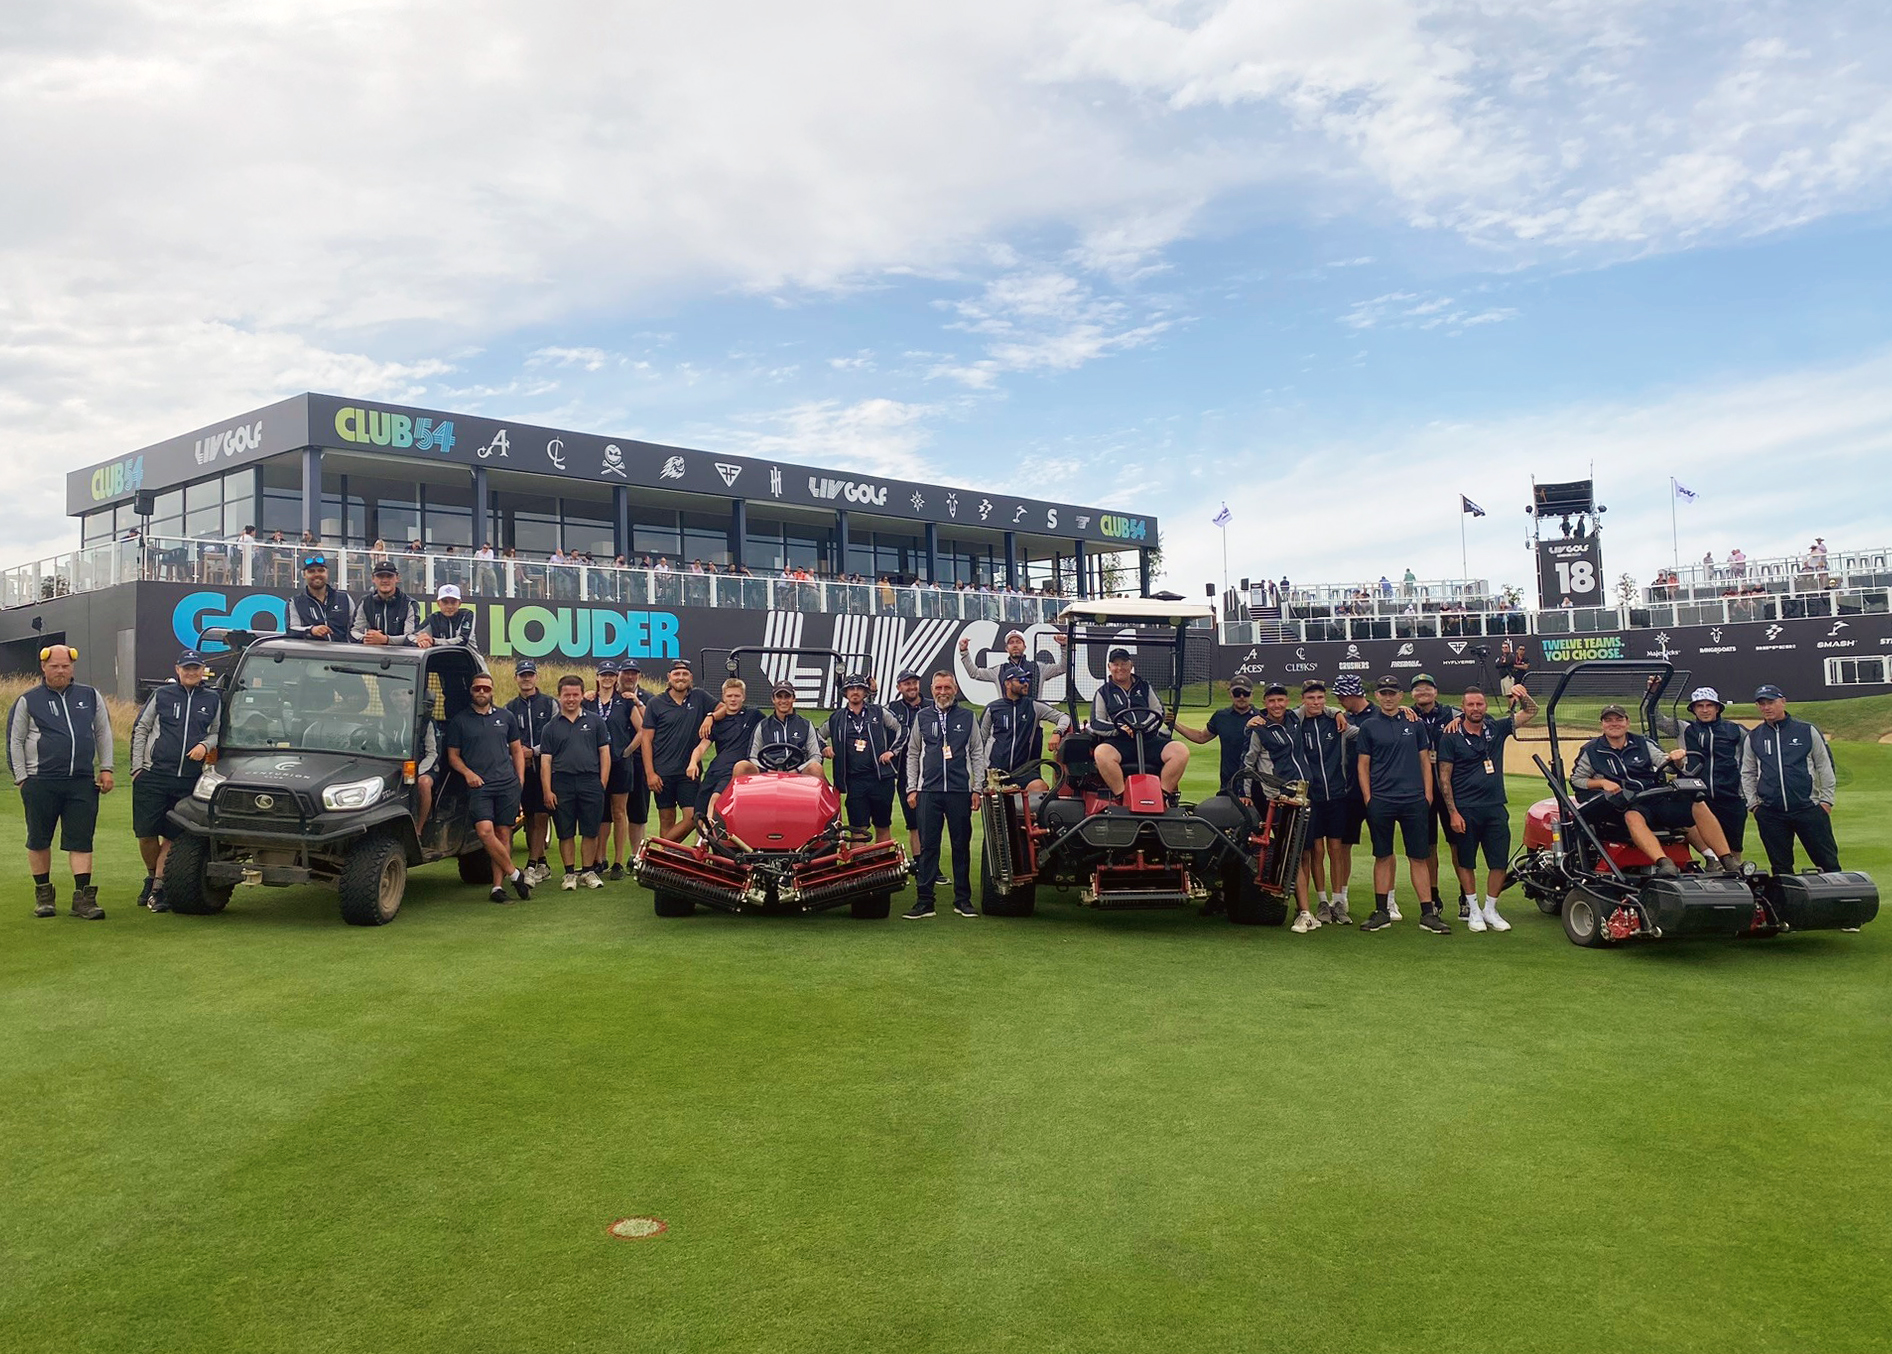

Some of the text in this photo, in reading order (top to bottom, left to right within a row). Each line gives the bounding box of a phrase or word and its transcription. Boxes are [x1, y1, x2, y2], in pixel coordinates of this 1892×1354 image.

[1555, 560, 1596, 594] 18
[489, 604, 680, 659] LOUDER
[1542, 636, 1625, 650] TWELVE TEAMS.
[1817, 640, 1855, 649] SMASH
[1544, 648, 1624, 661] YOU CHOOSE.
[1234, 663, 1263, 675] ACES
[245, 771, 311, 780] CENTURION
